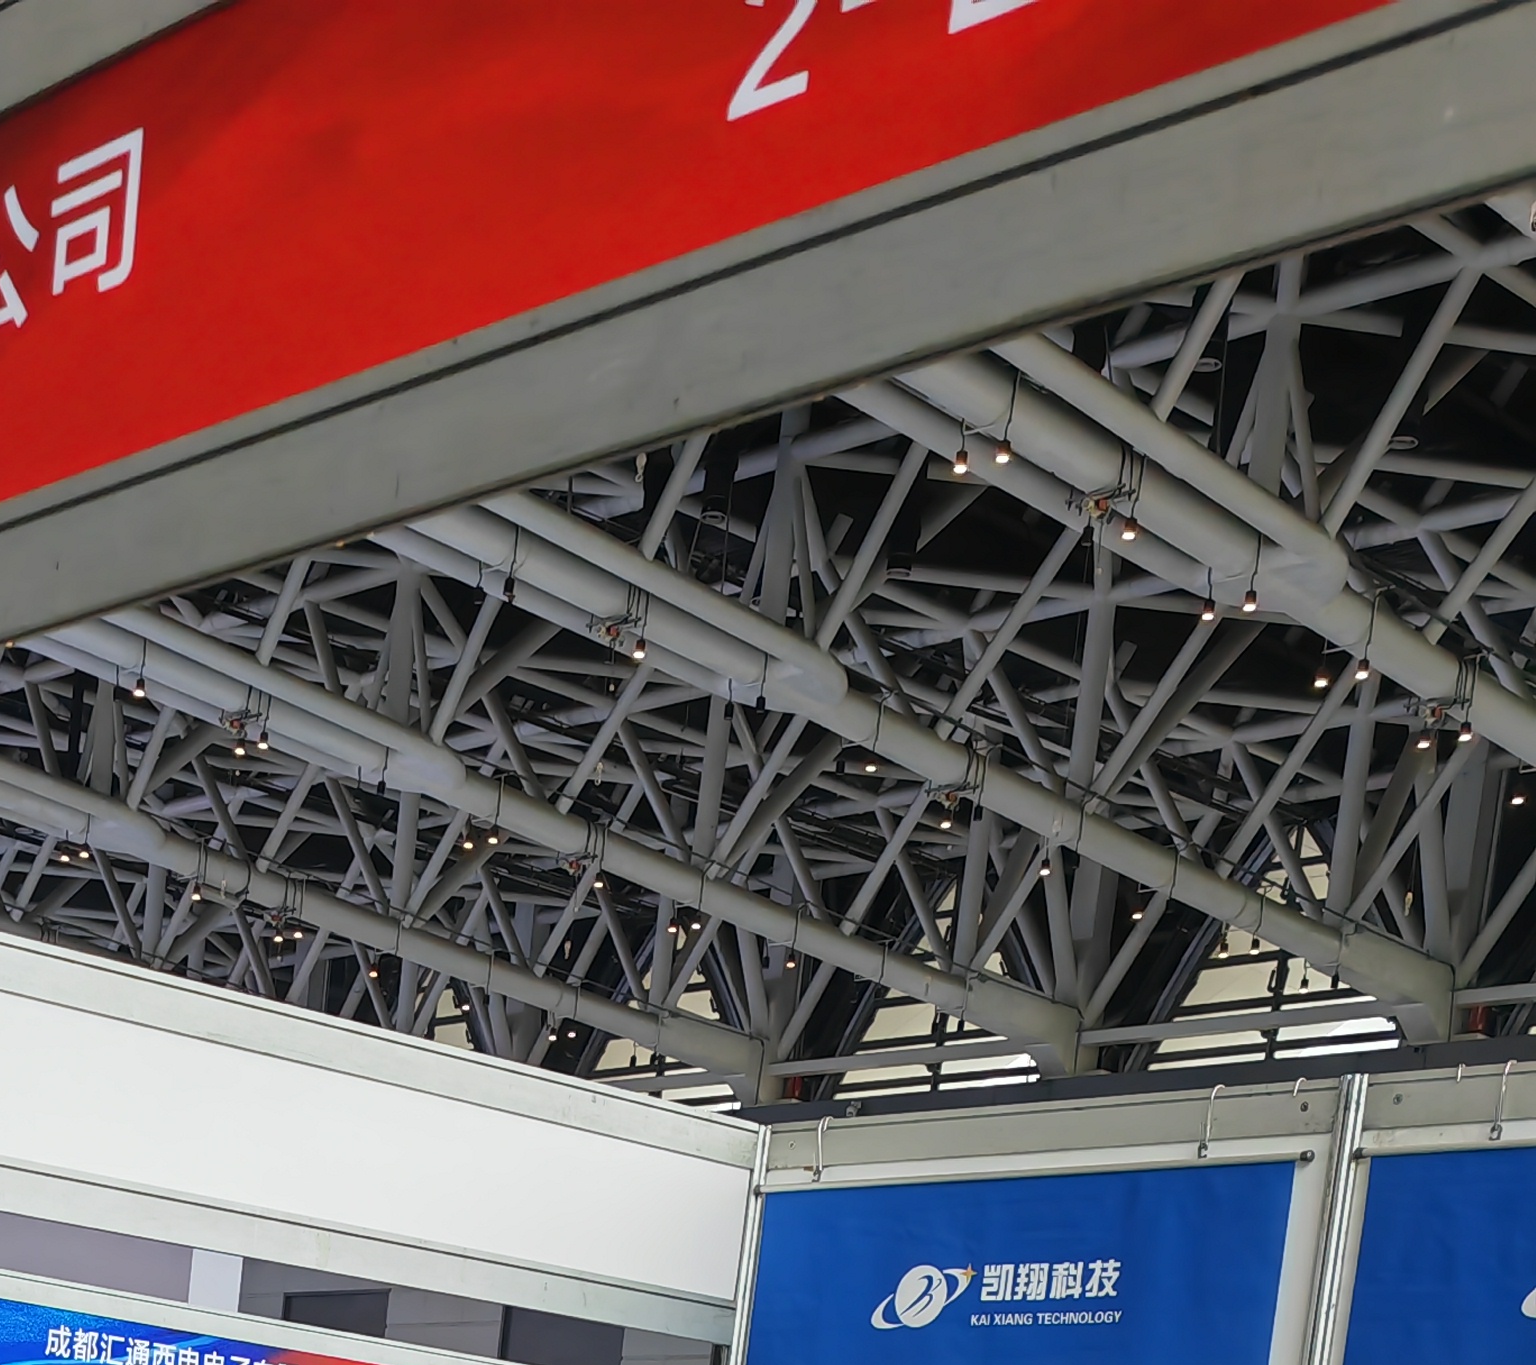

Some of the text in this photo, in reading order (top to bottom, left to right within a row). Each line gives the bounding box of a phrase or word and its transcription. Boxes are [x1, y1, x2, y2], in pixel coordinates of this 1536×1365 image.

[980, 1258, 1122, 1301] 凯翔科技
[970, 1310, 1123, 1327] KAI XIANG TECHNOLOGY
